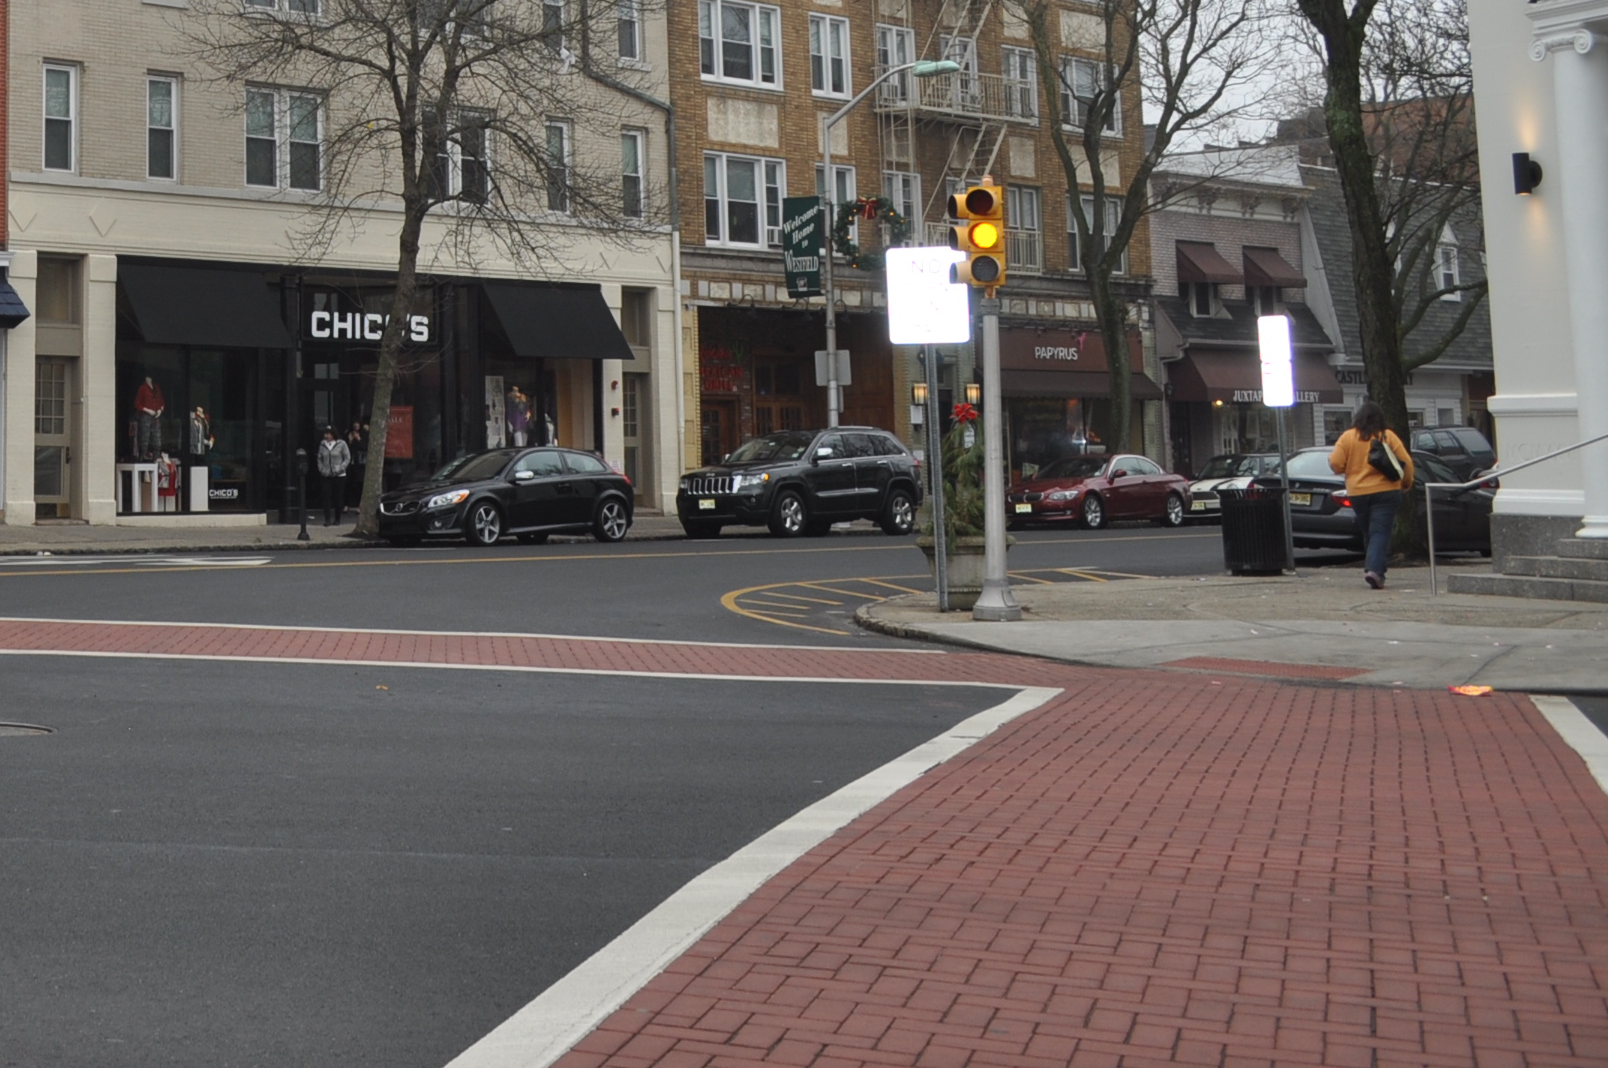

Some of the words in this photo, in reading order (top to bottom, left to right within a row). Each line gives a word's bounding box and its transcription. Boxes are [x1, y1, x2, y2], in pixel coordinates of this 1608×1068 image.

[783, 205, 819, 234] Welcome
[792, 222, 815, 245] Home
[801, 239, 809, 248] to
[311, 311, 429, 342] CHIC'S
[1034, 346, 1079, 361] PAPYRUS
